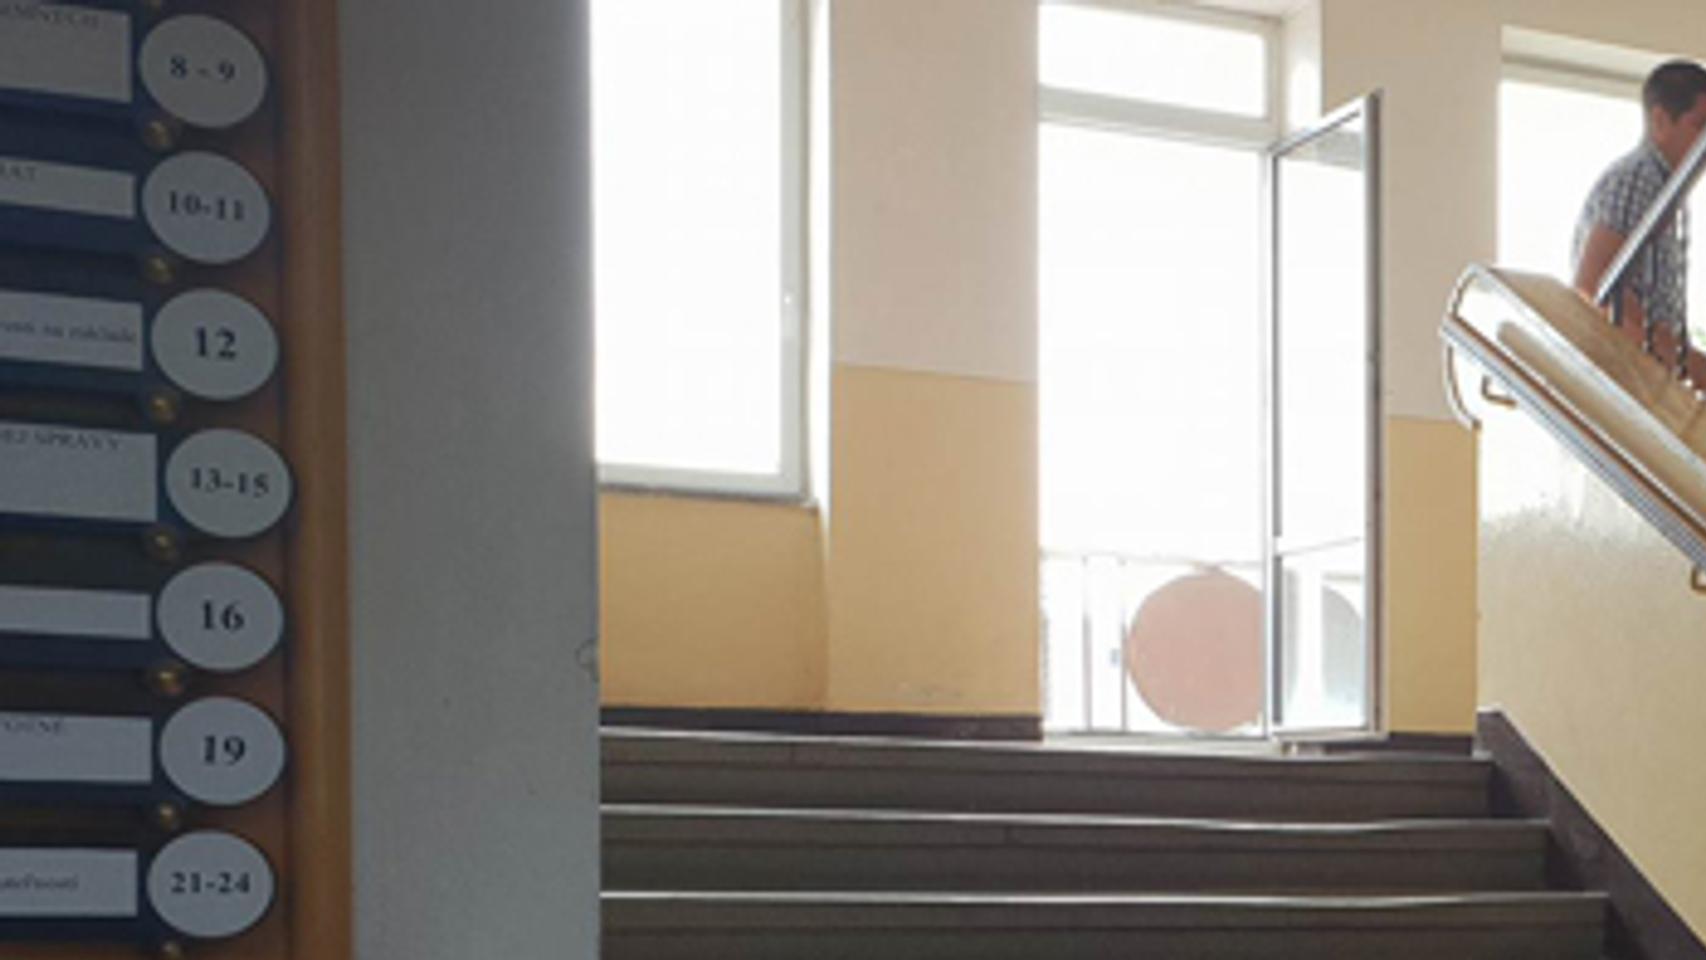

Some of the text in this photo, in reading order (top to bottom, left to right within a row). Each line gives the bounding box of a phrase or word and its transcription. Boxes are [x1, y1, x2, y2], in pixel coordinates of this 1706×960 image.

[170, 55, 188, 79] 8
[217, 60, 236, 83] 9
[168, 190, 245, 222] 10-11
[195, 327, 238, 360] 12
[190, 467, 270, 498] 13-15
[201, 600, 245, 631] 16
[203, 735, 246, 765] 19
[170, 871, 251, 895] 21-24
